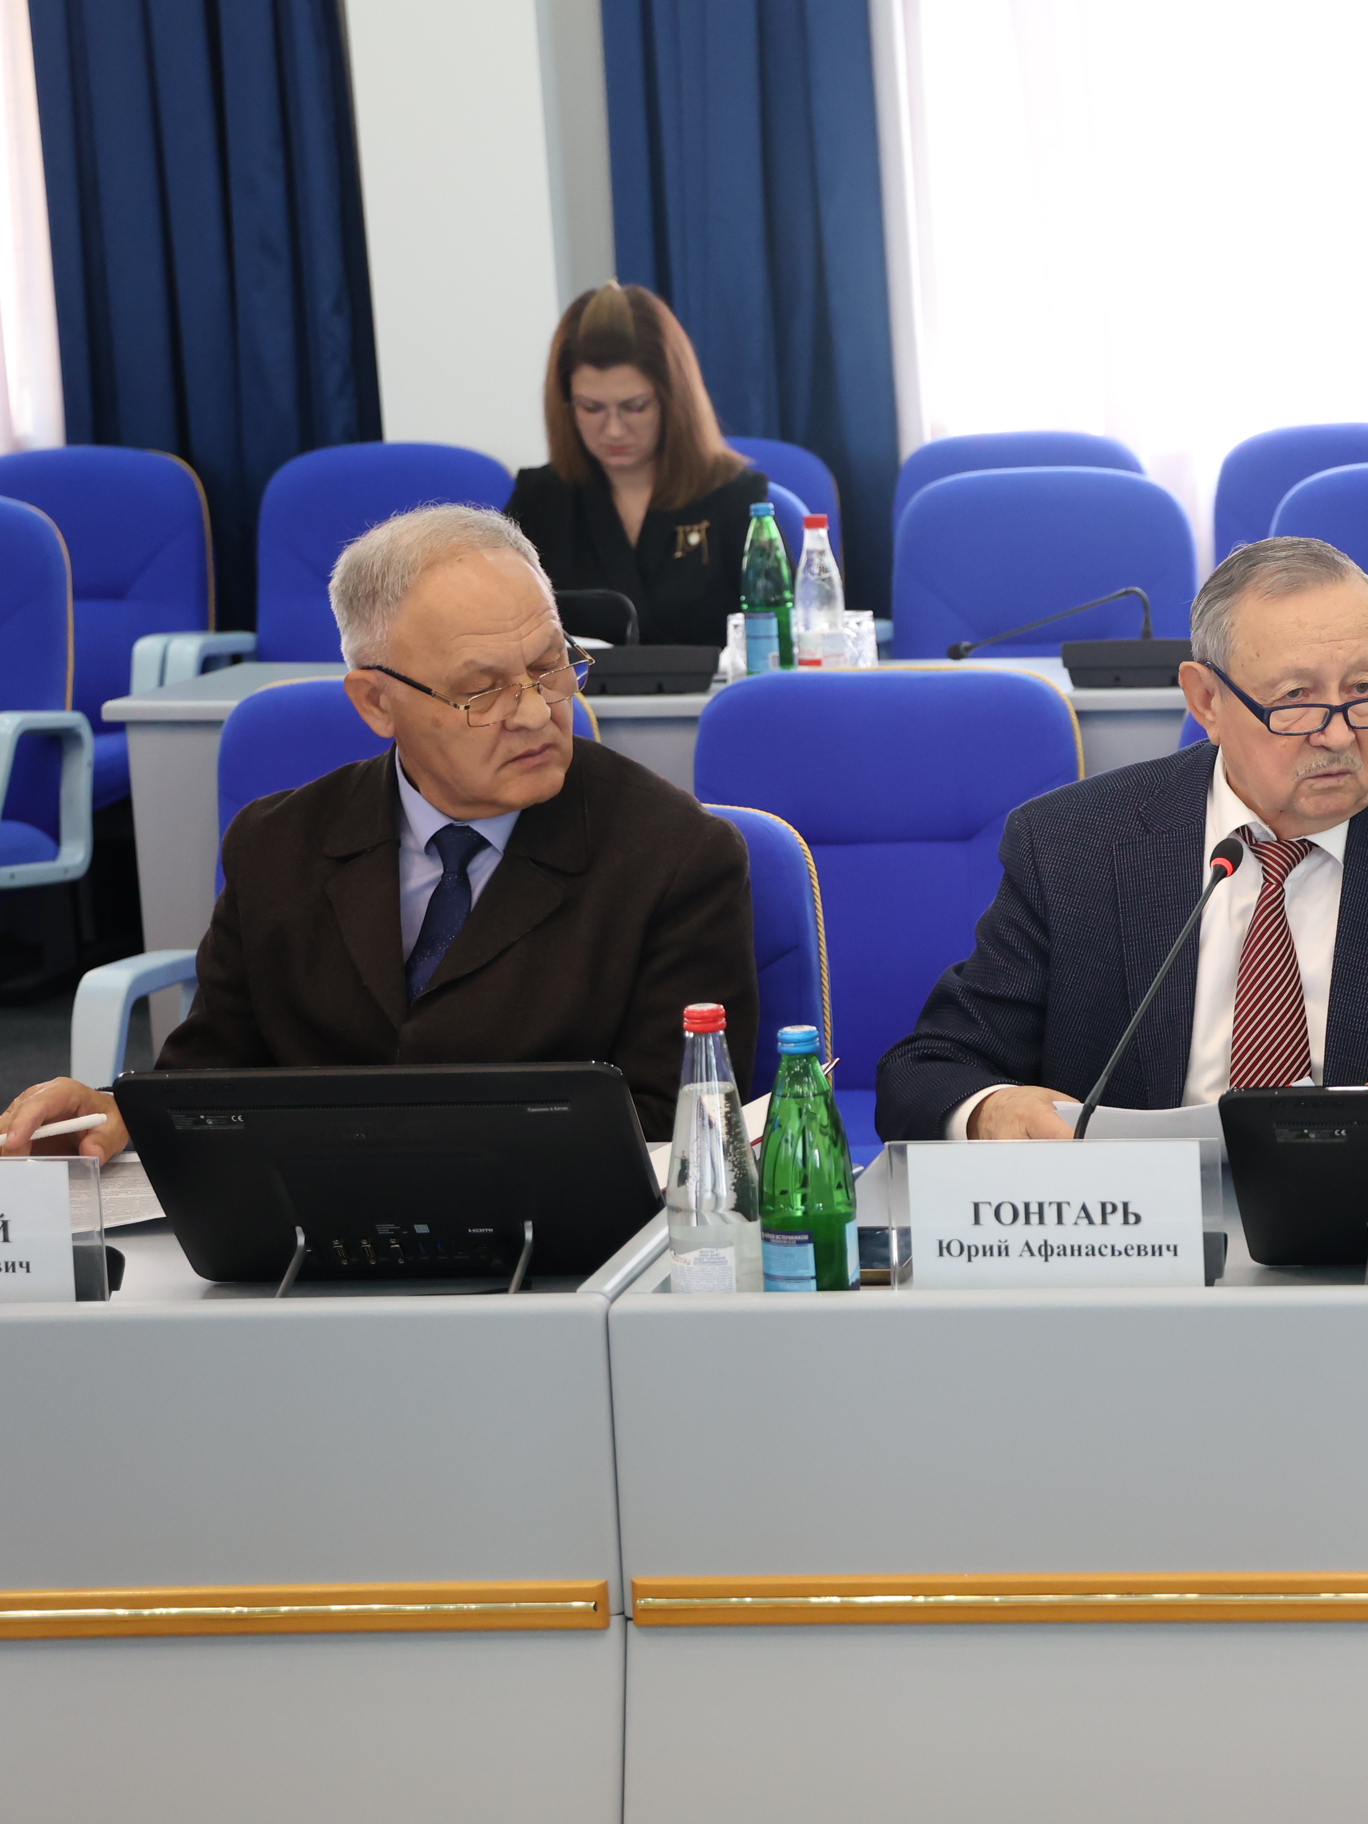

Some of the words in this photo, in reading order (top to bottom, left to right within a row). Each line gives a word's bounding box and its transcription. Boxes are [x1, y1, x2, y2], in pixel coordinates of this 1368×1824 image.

[971, 1201, 1143, 1226] ГОНТАРЬ
[936, 1238, 1010, 1263] Юрий
[1018, 1238, 1179, 1263] Афанасьевич
[0, 1260, 31, 1273] ич
